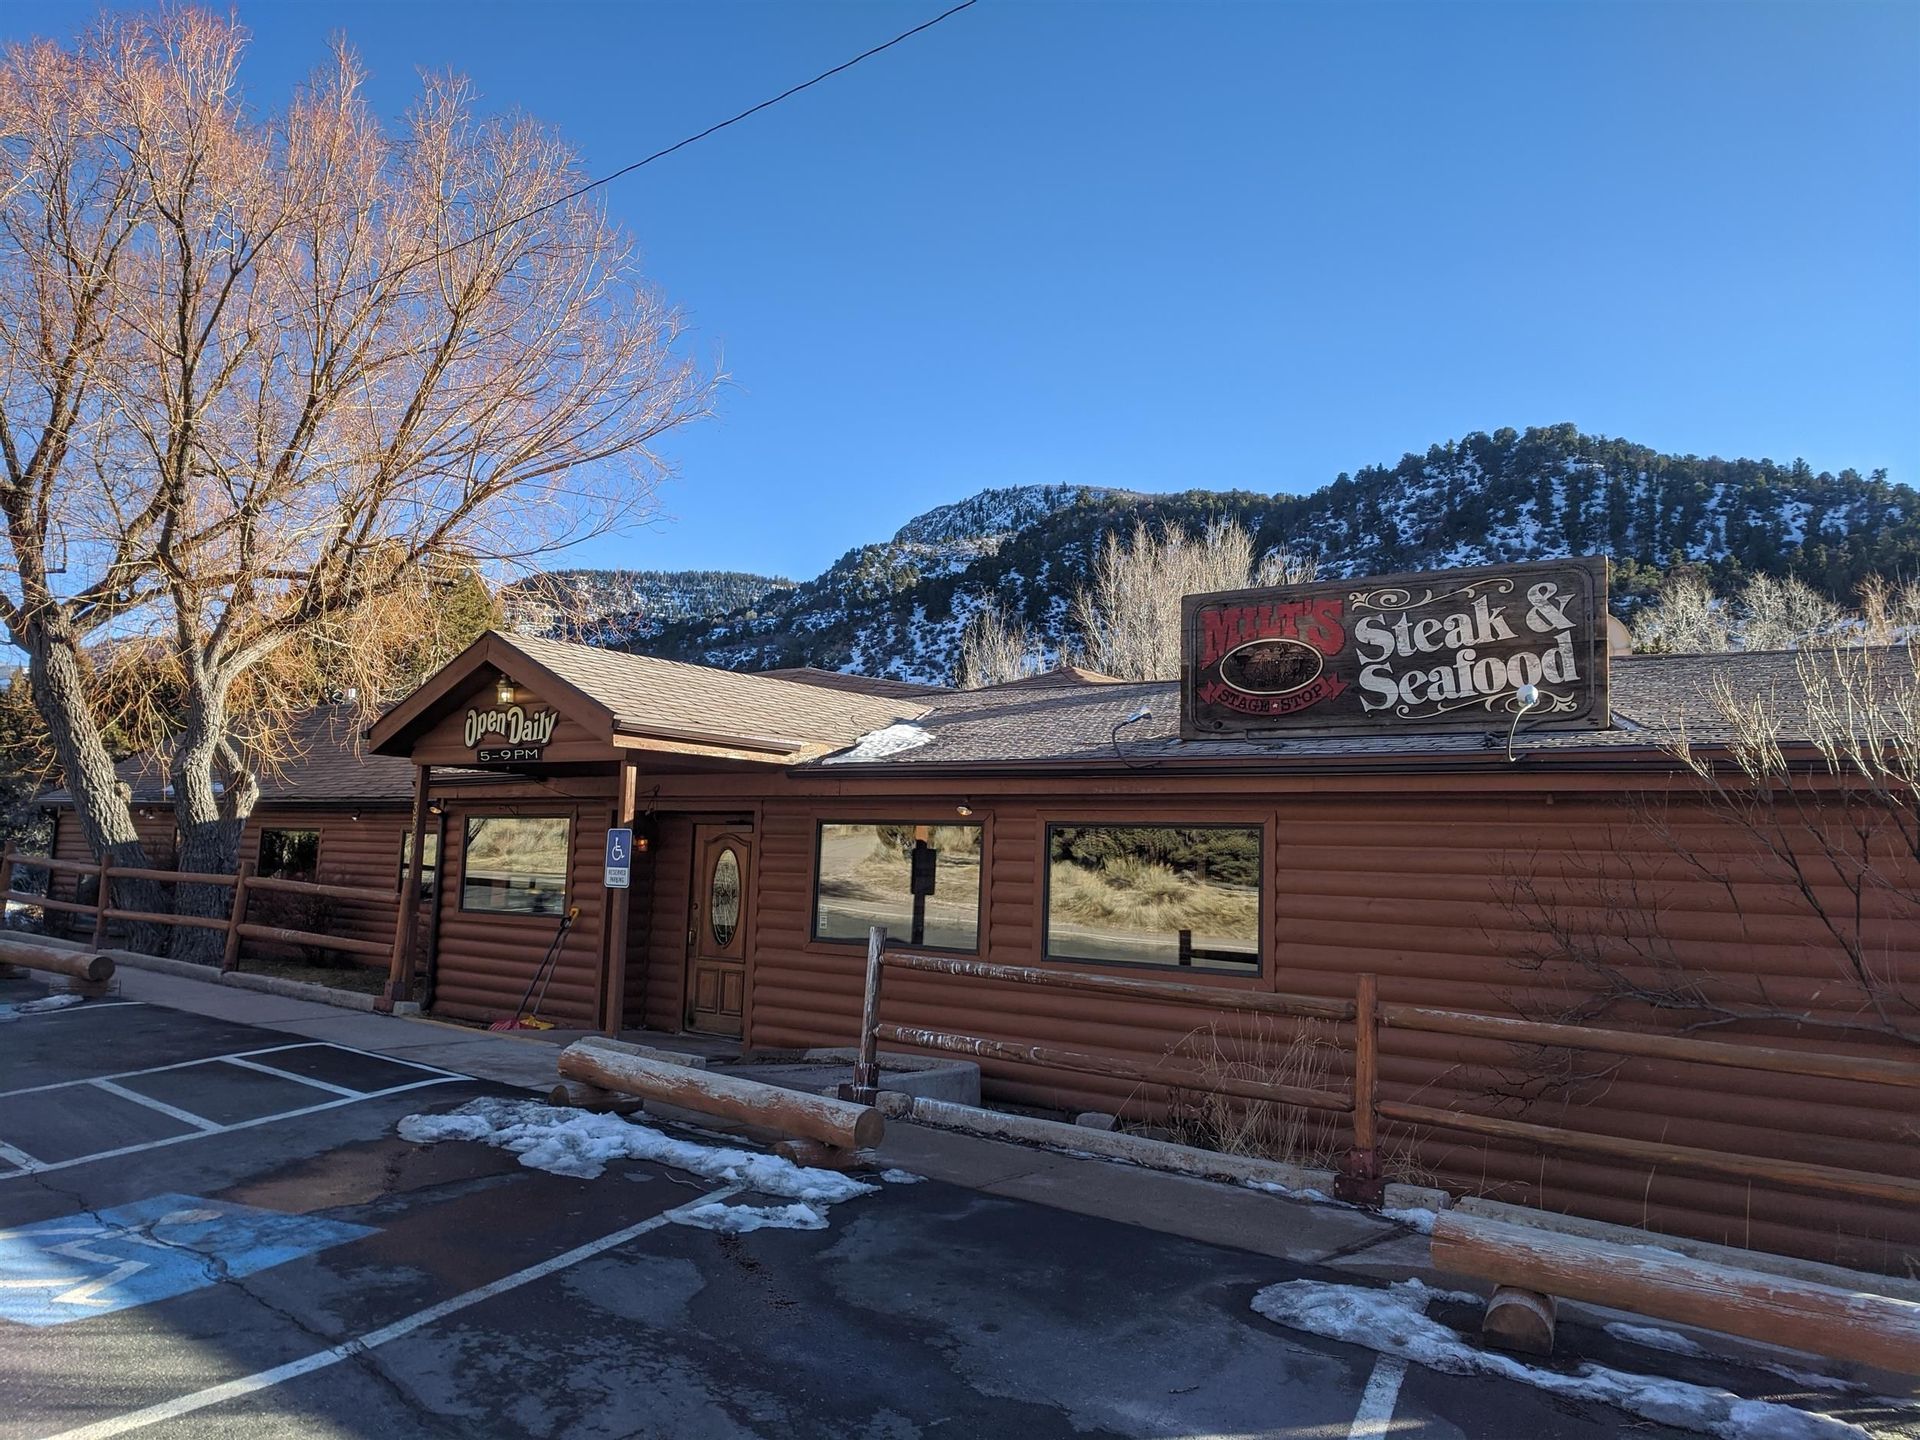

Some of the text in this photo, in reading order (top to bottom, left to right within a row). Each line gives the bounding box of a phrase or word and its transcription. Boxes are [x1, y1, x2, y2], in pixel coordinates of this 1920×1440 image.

[1200, 598, 1345, 670] MILT'S
[1354, 582, 1577, 666] Steak &
[1217, 682, 1324, 713] STAGE STOP
[1358, 630, 1581, 713] Seafood
[464, 706, 559, 748] Open Daily
